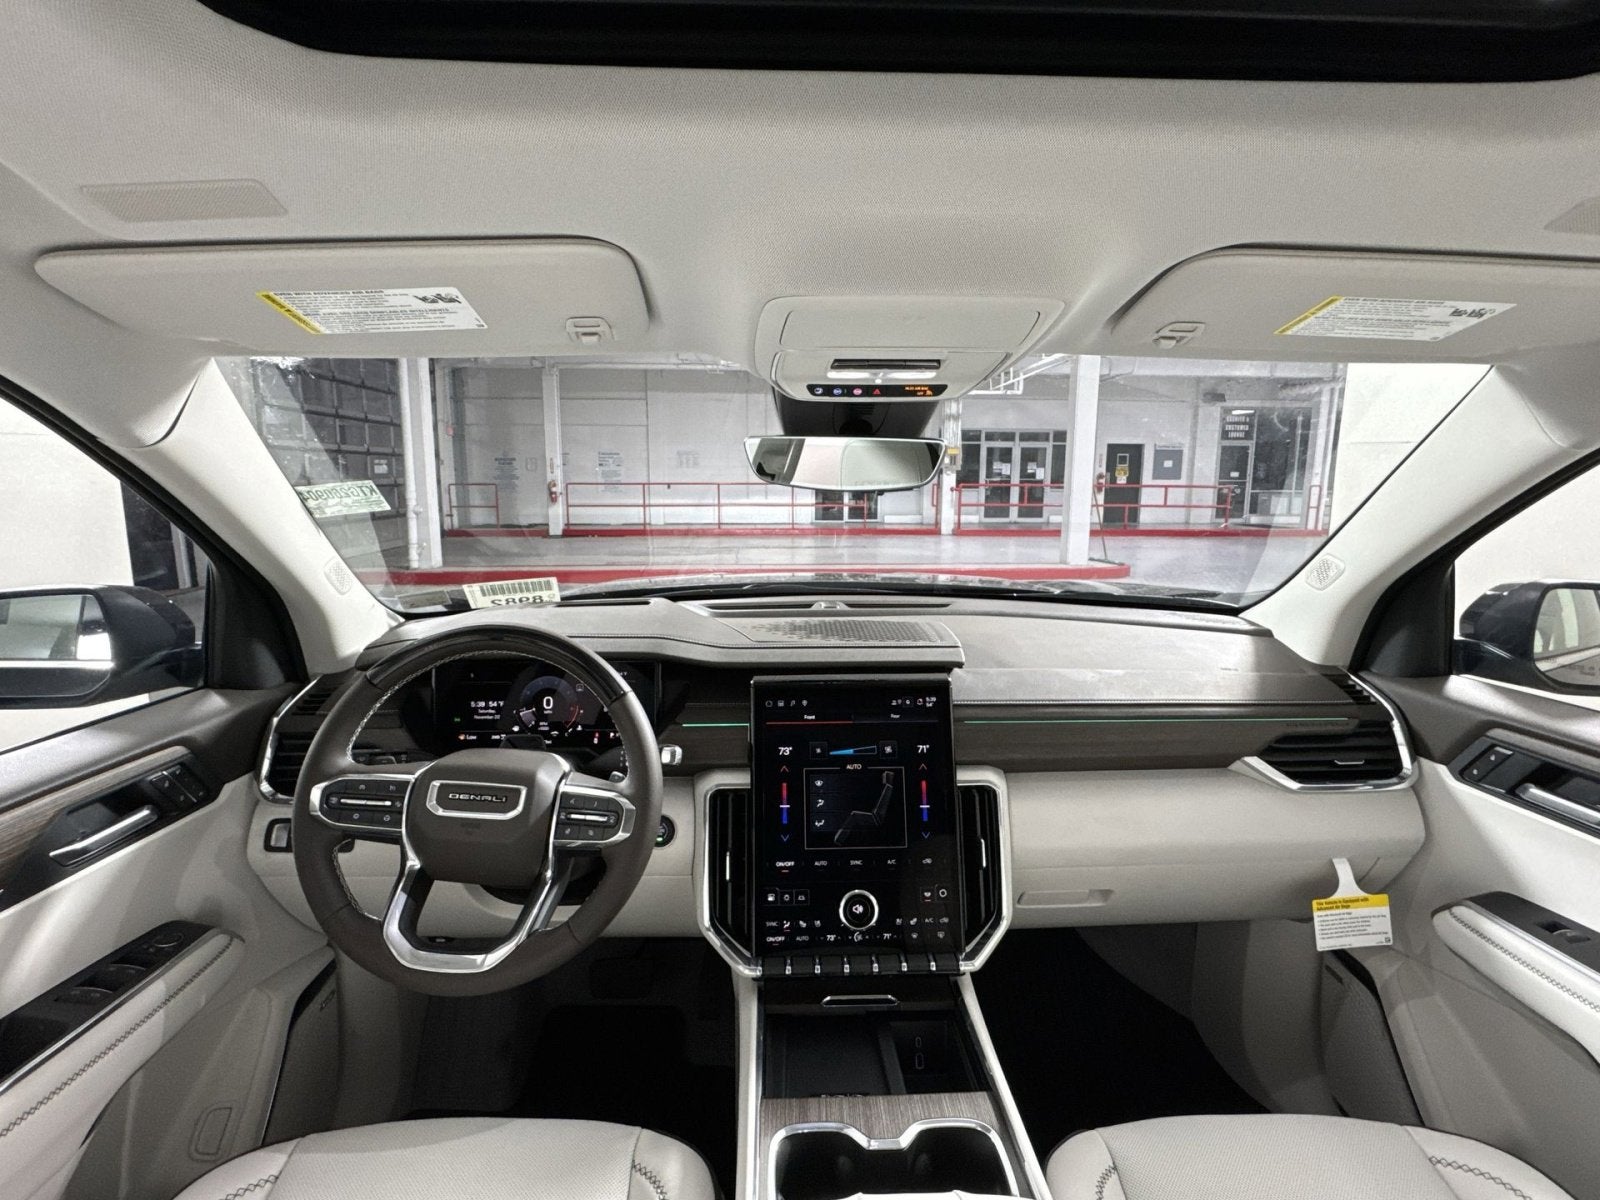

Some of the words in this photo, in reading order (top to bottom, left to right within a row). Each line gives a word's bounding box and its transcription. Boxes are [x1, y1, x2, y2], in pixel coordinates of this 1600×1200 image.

[543, 696, 553, 709] 0
[778, 746, 792, 755] 73°
[917, 745, 930, 753] 71°
[448, 793, 506, 802] DENALI
